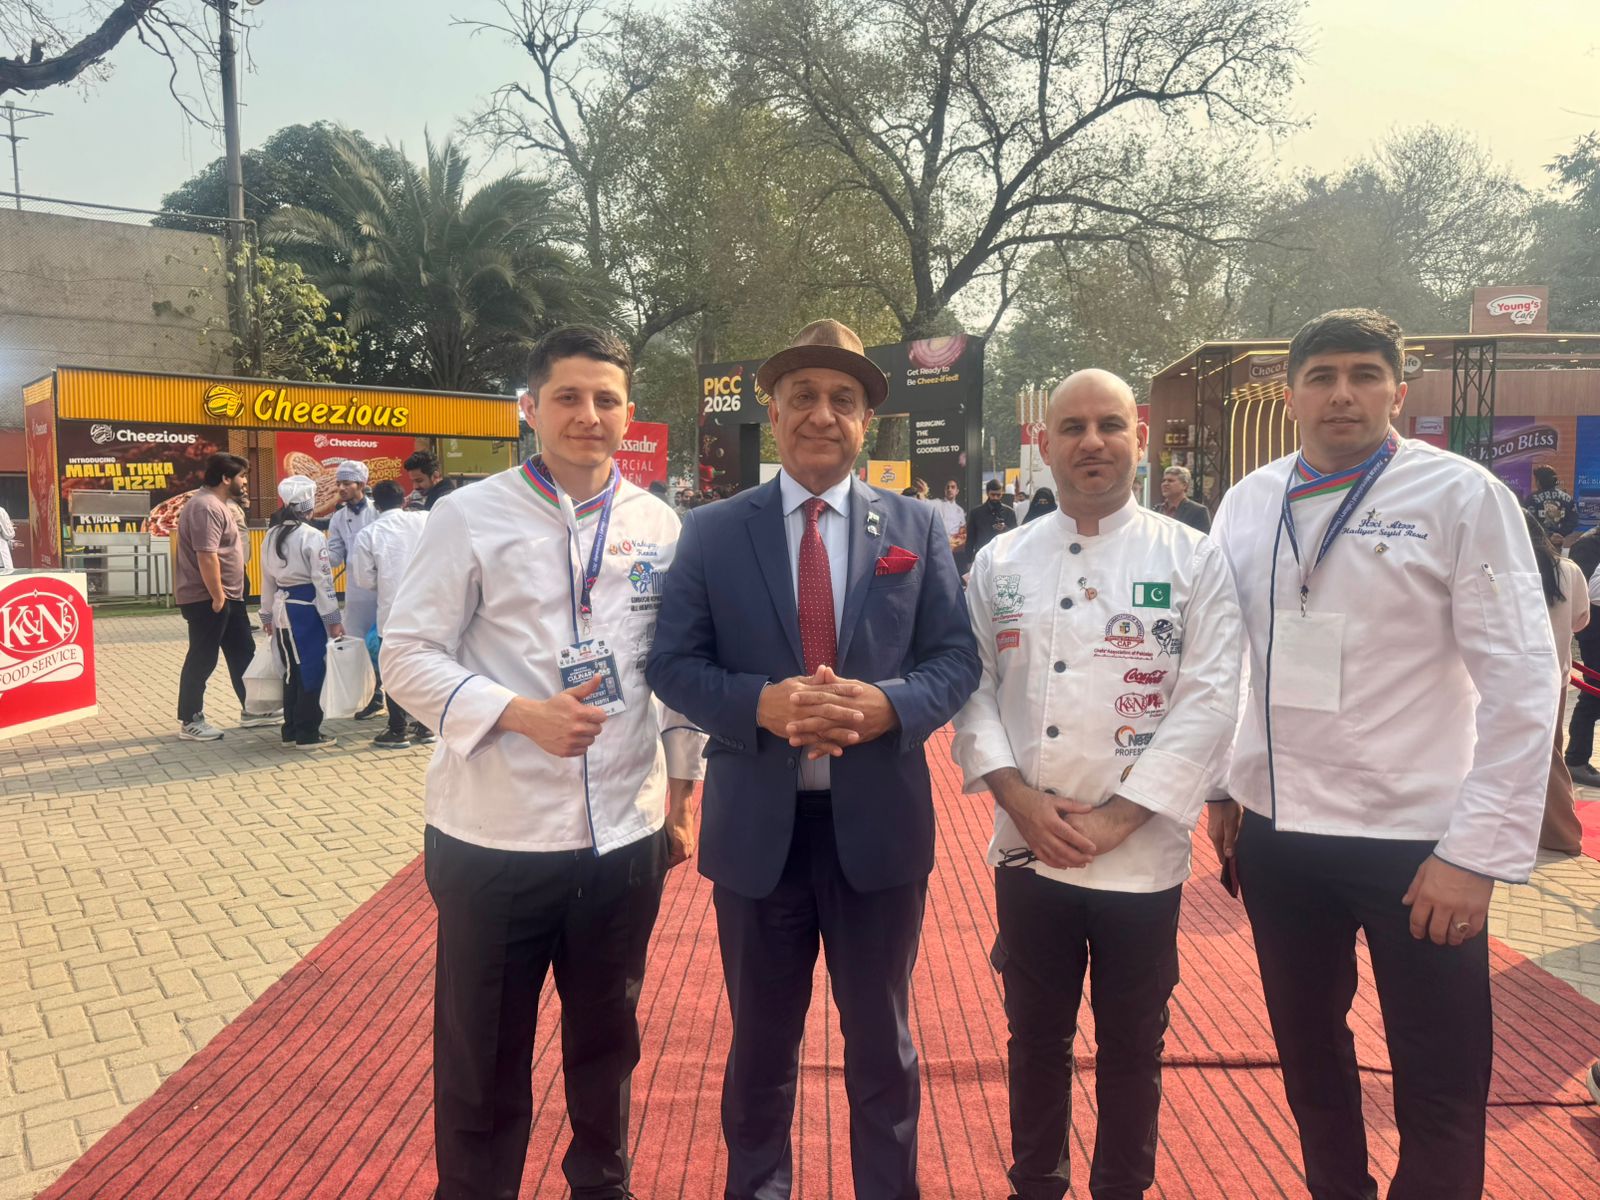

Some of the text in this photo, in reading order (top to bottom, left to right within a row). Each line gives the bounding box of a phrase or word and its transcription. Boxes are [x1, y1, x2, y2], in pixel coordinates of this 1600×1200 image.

[1497, 300, 1539, 311] Young's
[920, 367, 941, 376] Ready
[1252, 364, 1281, 376] Choco
[704, 375, 742, 396] PICC
[254, 388, 409, 427] Cheezious
[704, 395, 741, 413] 2026
[916, 420, 945, 428] BRINGING
[116, 429, 197, 443] Cheezious
[329, 438, 378, 448] Cheezious
[618, 435, 657, 453] ssador
[916, 446, 950, 454] GOODNESS
[1469, 431, 1554, 460] hoco Bliss
[65, 462, 174, 478] MALAI TIKKA
[112, 475, 169, 491] PIZZA
[0, 602, 74, 648] K&N's
[32, 648, 77, 673] SERVICE
[1115, 747, 1145, 756] PROFES
